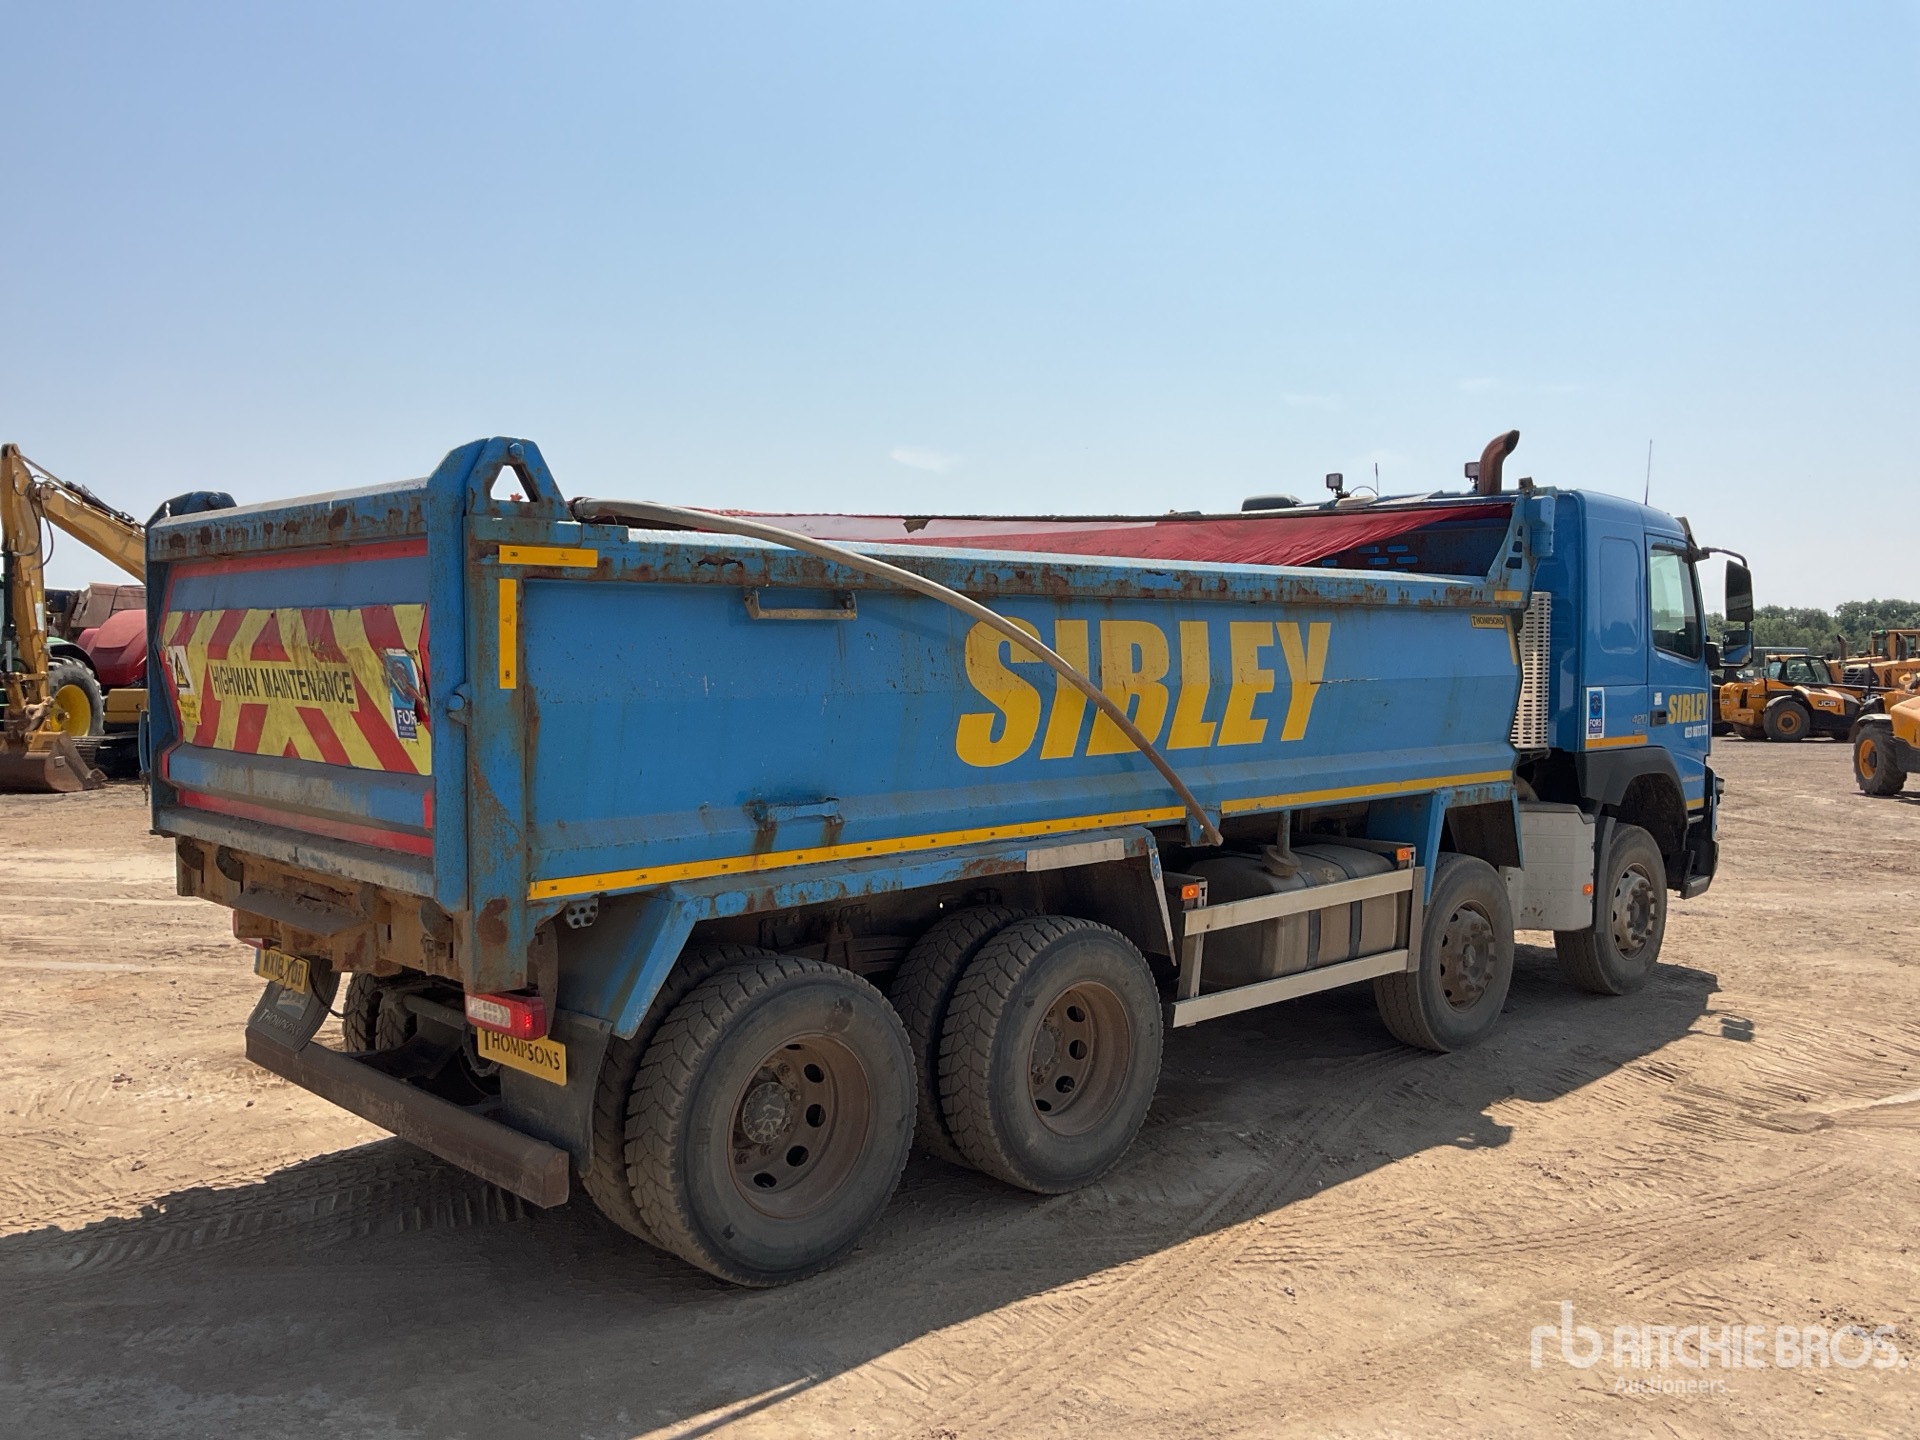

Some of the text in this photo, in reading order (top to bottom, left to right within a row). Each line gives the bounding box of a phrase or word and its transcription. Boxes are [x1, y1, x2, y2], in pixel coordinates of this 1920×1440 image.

[211, 665, 354, 704] HIGHWAY MAINTENANCE
[956, 616, 1332, 768] SIBLEY
[396, 709, 418, 726] FOR
[1667, 692, 1708, 725] SIBLEY
[482, 1029, 560, 1070] THOMPSONS
